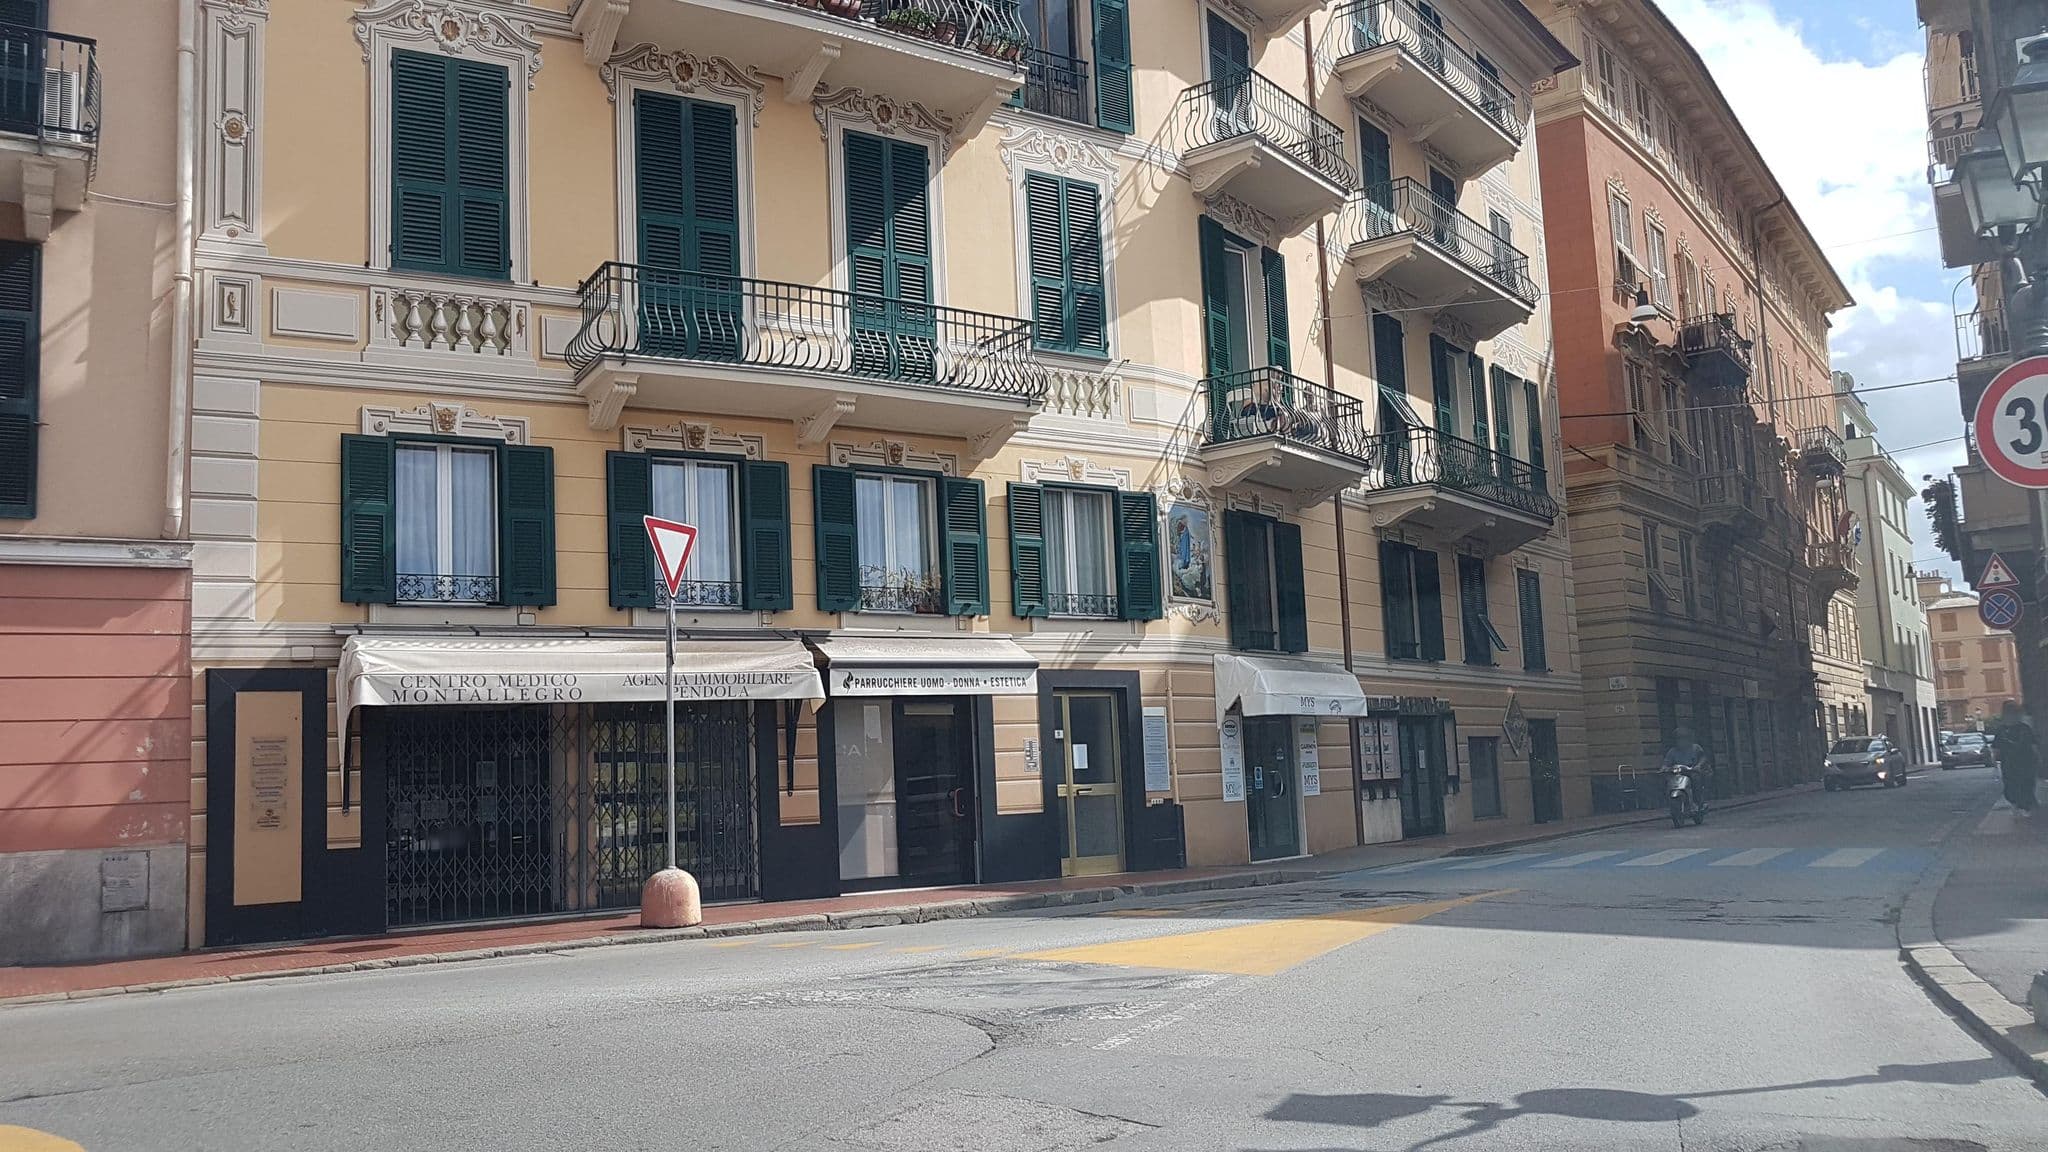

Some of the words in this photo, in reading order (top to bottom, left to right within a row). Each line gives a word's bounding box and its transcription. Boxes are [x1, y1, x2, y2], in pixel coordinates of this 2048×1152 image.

[2005, 394, 2048, 456] 3
[400, 674, 487, 689] CENTRO
[498, 673, 577, 688] MEDICO
[622, 674, 689, 687] AGENIA
[694, 673, 793, 686] IMMOBILIARE
[854, 677, 918, 689] PARRUCCHIERE
[920, 677, 945, 688] UOMO
[953, 677, 980, 688] DONNA
[990, 677, 1027, 687] ESTETICA
[392, 687, 583, 703] MONTALLEGRO
[1300, 696, 1315, 708] MYS
[1303, 774, 1318, 786] MYS
